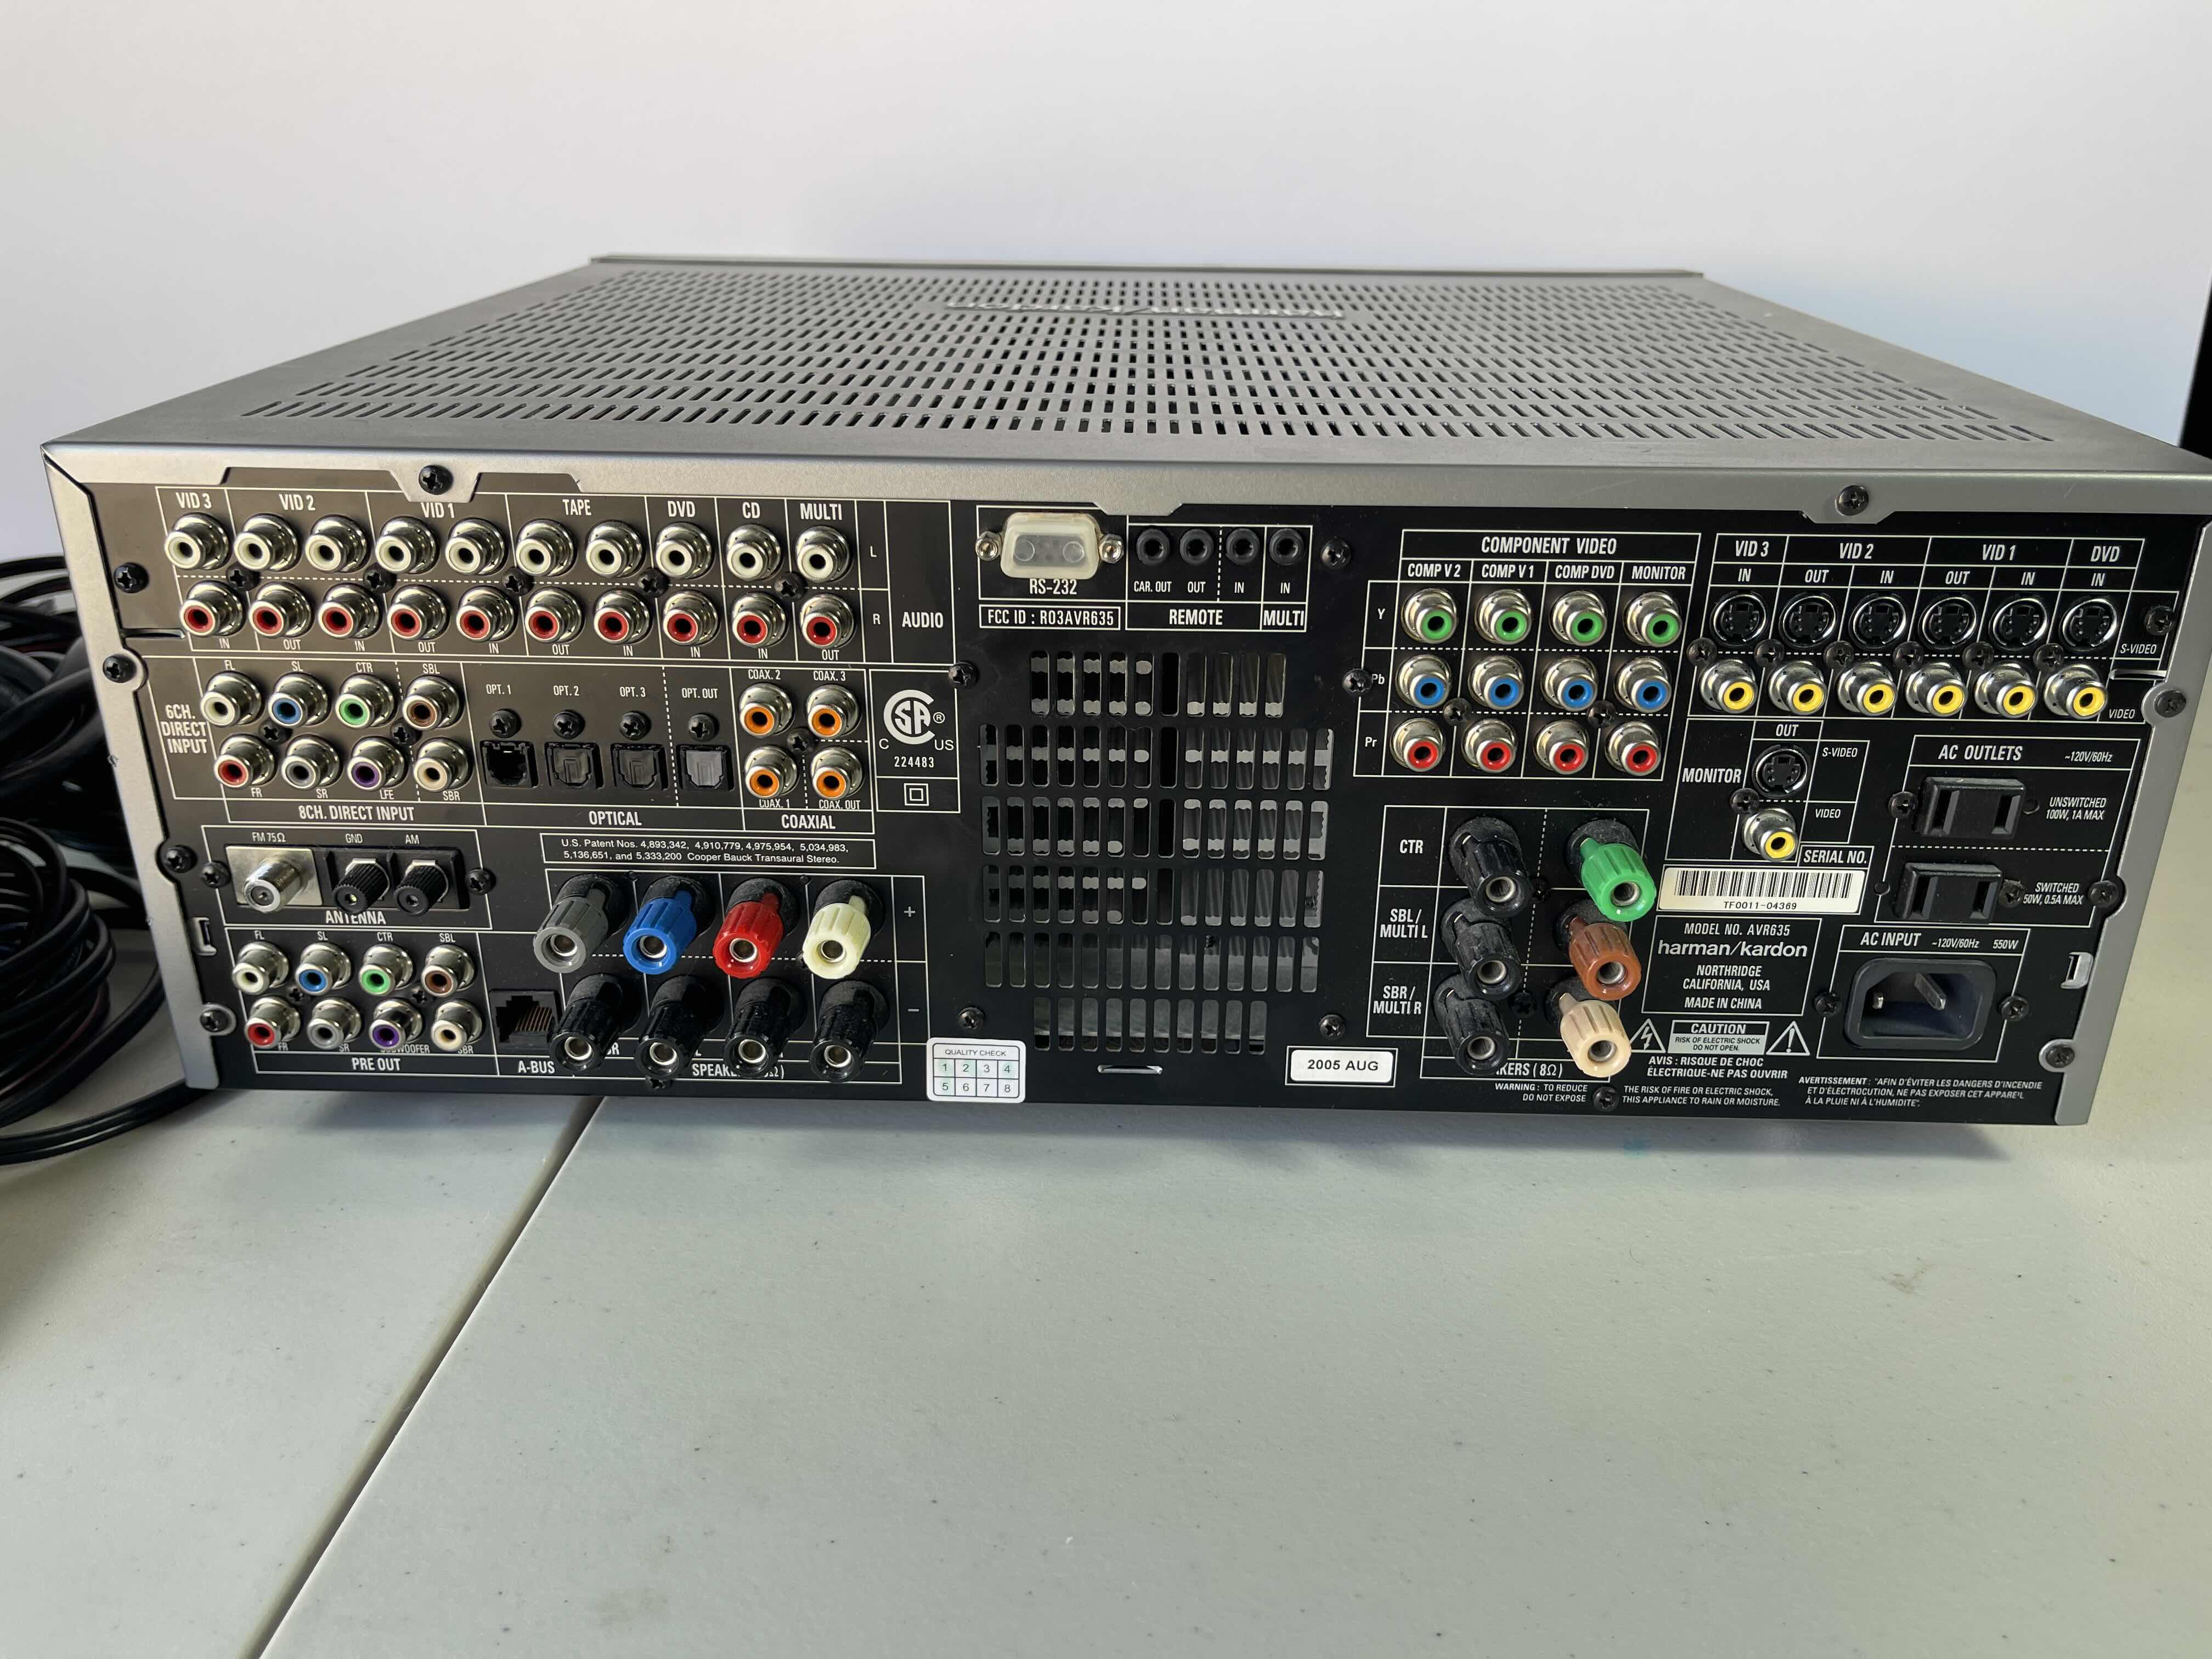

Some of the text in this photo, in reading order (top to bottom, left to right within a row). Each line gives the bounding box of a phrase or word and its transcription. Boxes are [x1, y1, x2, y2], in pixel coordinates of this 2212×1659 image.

[176, 492, 211, 509] VID 3
[422, 503, 455, 518] VID 1
[562, 499, 591, 516] TAPE
[668, 501, 696, 517] DVD
[743, 502, 760, 518] CD
[800, 504, 842, 520] MULTI
[1481, 537, 1616, 555] COMPONENT VIDEO
[1735, 541, 1769, 556] VID 3
[1983, 545, 2016, 560] VID 1
[2090, 546, 2120, 562] DVD
[1408, 563, 1460, 577] COMP V 2
[1555, 566, 1615, 579] COMP DVD
[1632, 567, 1686, 580] MONITOR
[1029, 579, 1077, 595] RS-232
[1134, 581, 1172, 592] CAR. OUT
[1188, 582, 1205, 593] OUT
[1234, 582, 1244, 594] IN
[902, 612, 943, 628] AUDIO
[988, 610, 1009, 624] FCC
[1015, 610, 1025, 624] ID
[1169, 609, 1223, 625] REMOTE
[1263, 610, 1305, 626] MULTI
[2120, 644, 2157, 654] S-VIDEO
[225, 660, 235, 670] FL
[292, 661, 303, 672] SL
[356, 662, 373, 673] CTR
[422, 663, 439, 674] SBL
[748, 669, 781, 680] COAX. 2
[1372, 674, 1385, 684] Pb
[486, 684, 511, 695] OPT. 1
[681, 688, 718, 699] OPT. OUT
[166, 704, 195, 719] 6CH.
[2109, 709, 2135, 719] VIDEO
[163, 722, 206, 737] DIRECT
[167, 739, 207, 754] INPUT
[934, 740, 953, 750] US
[1365, 737, 1377, 747] Pr
[1822, 748, 1857, 758] S-VIDEO
[1938, 745, 1958, 760] AC
[1964, 746, 2023, 760] OUTLETS
[894, 757, 934, 768] 224483
[1682, 768, 1741, 783] MONITOR
[380, 789, 394, 799] LFE
[443, 791, 460, 801] SBR
[2049, 797, 2106, 808] UNSWITCHED
[299, 805, 414, 820] 8CH. DIRECT INPUT
[589, 811, 641, 826] OPTICAL
[1815, 809, 1841, 818] VIDEO
[2046, 809, 2104, 820] 100W, 1A MAX
[781, 814, 836, 829] COAXIAL
[252, 833, 266, 842] FM
[346, 834, 363, 843] GND
[405, 835, 420, 844] AM
[562, 839, 848, 853] U.S. Patent Nos. 4,893,342, 4,910,779, 4,975,954, 5,034,983,
[1400, 839, 1423, 854] CTR
[564, 851, 839, 864] 5,136,651, and 5,333,200 Cooper Bauck Transaural Stereo.
[1803, 850, 1867, 864] SERIAL NO.
[2035, 883, 2079, 893] SWITCHED
[2044, 895, 2061, 904] 0.5A
[2063, 895, 2084, 905] MAX
[1380, 924, 1427, 938] MULTI L
[1684, 923, 1790, 936] MODEL NO. AVR635
[1860, 932, 1878, 945] AC
[1881, 933, 1921, 946] INPUT
[1993, 939, 2018, 949] 550W
[1658, 940, 1808, 957] harman/kardon
[1696, 965, 1762, 977] NORTHRIDGE
[1683, 979, 1770, 991] CALIFORNIA, USA
[1684, 997, 1762, 1009] MADE IN CHINA
[1691, 1024, 1746, 1034] CAUTION
[352, 1058, 400, 1071] PRE OUT
[518, 1060, 555, 1074] A-BUS
[1307, 1060, 1379, 1071] 2005 AUG
[1680, 1057, 1718, 1066] RISQUE
[1736, 1058, 1764, 1066] CHOC
[1647, 1066, 1725, 1077] ÉLECTRIQUE-NE
[1750, 1070, 1787, 1079] OUVRIR
